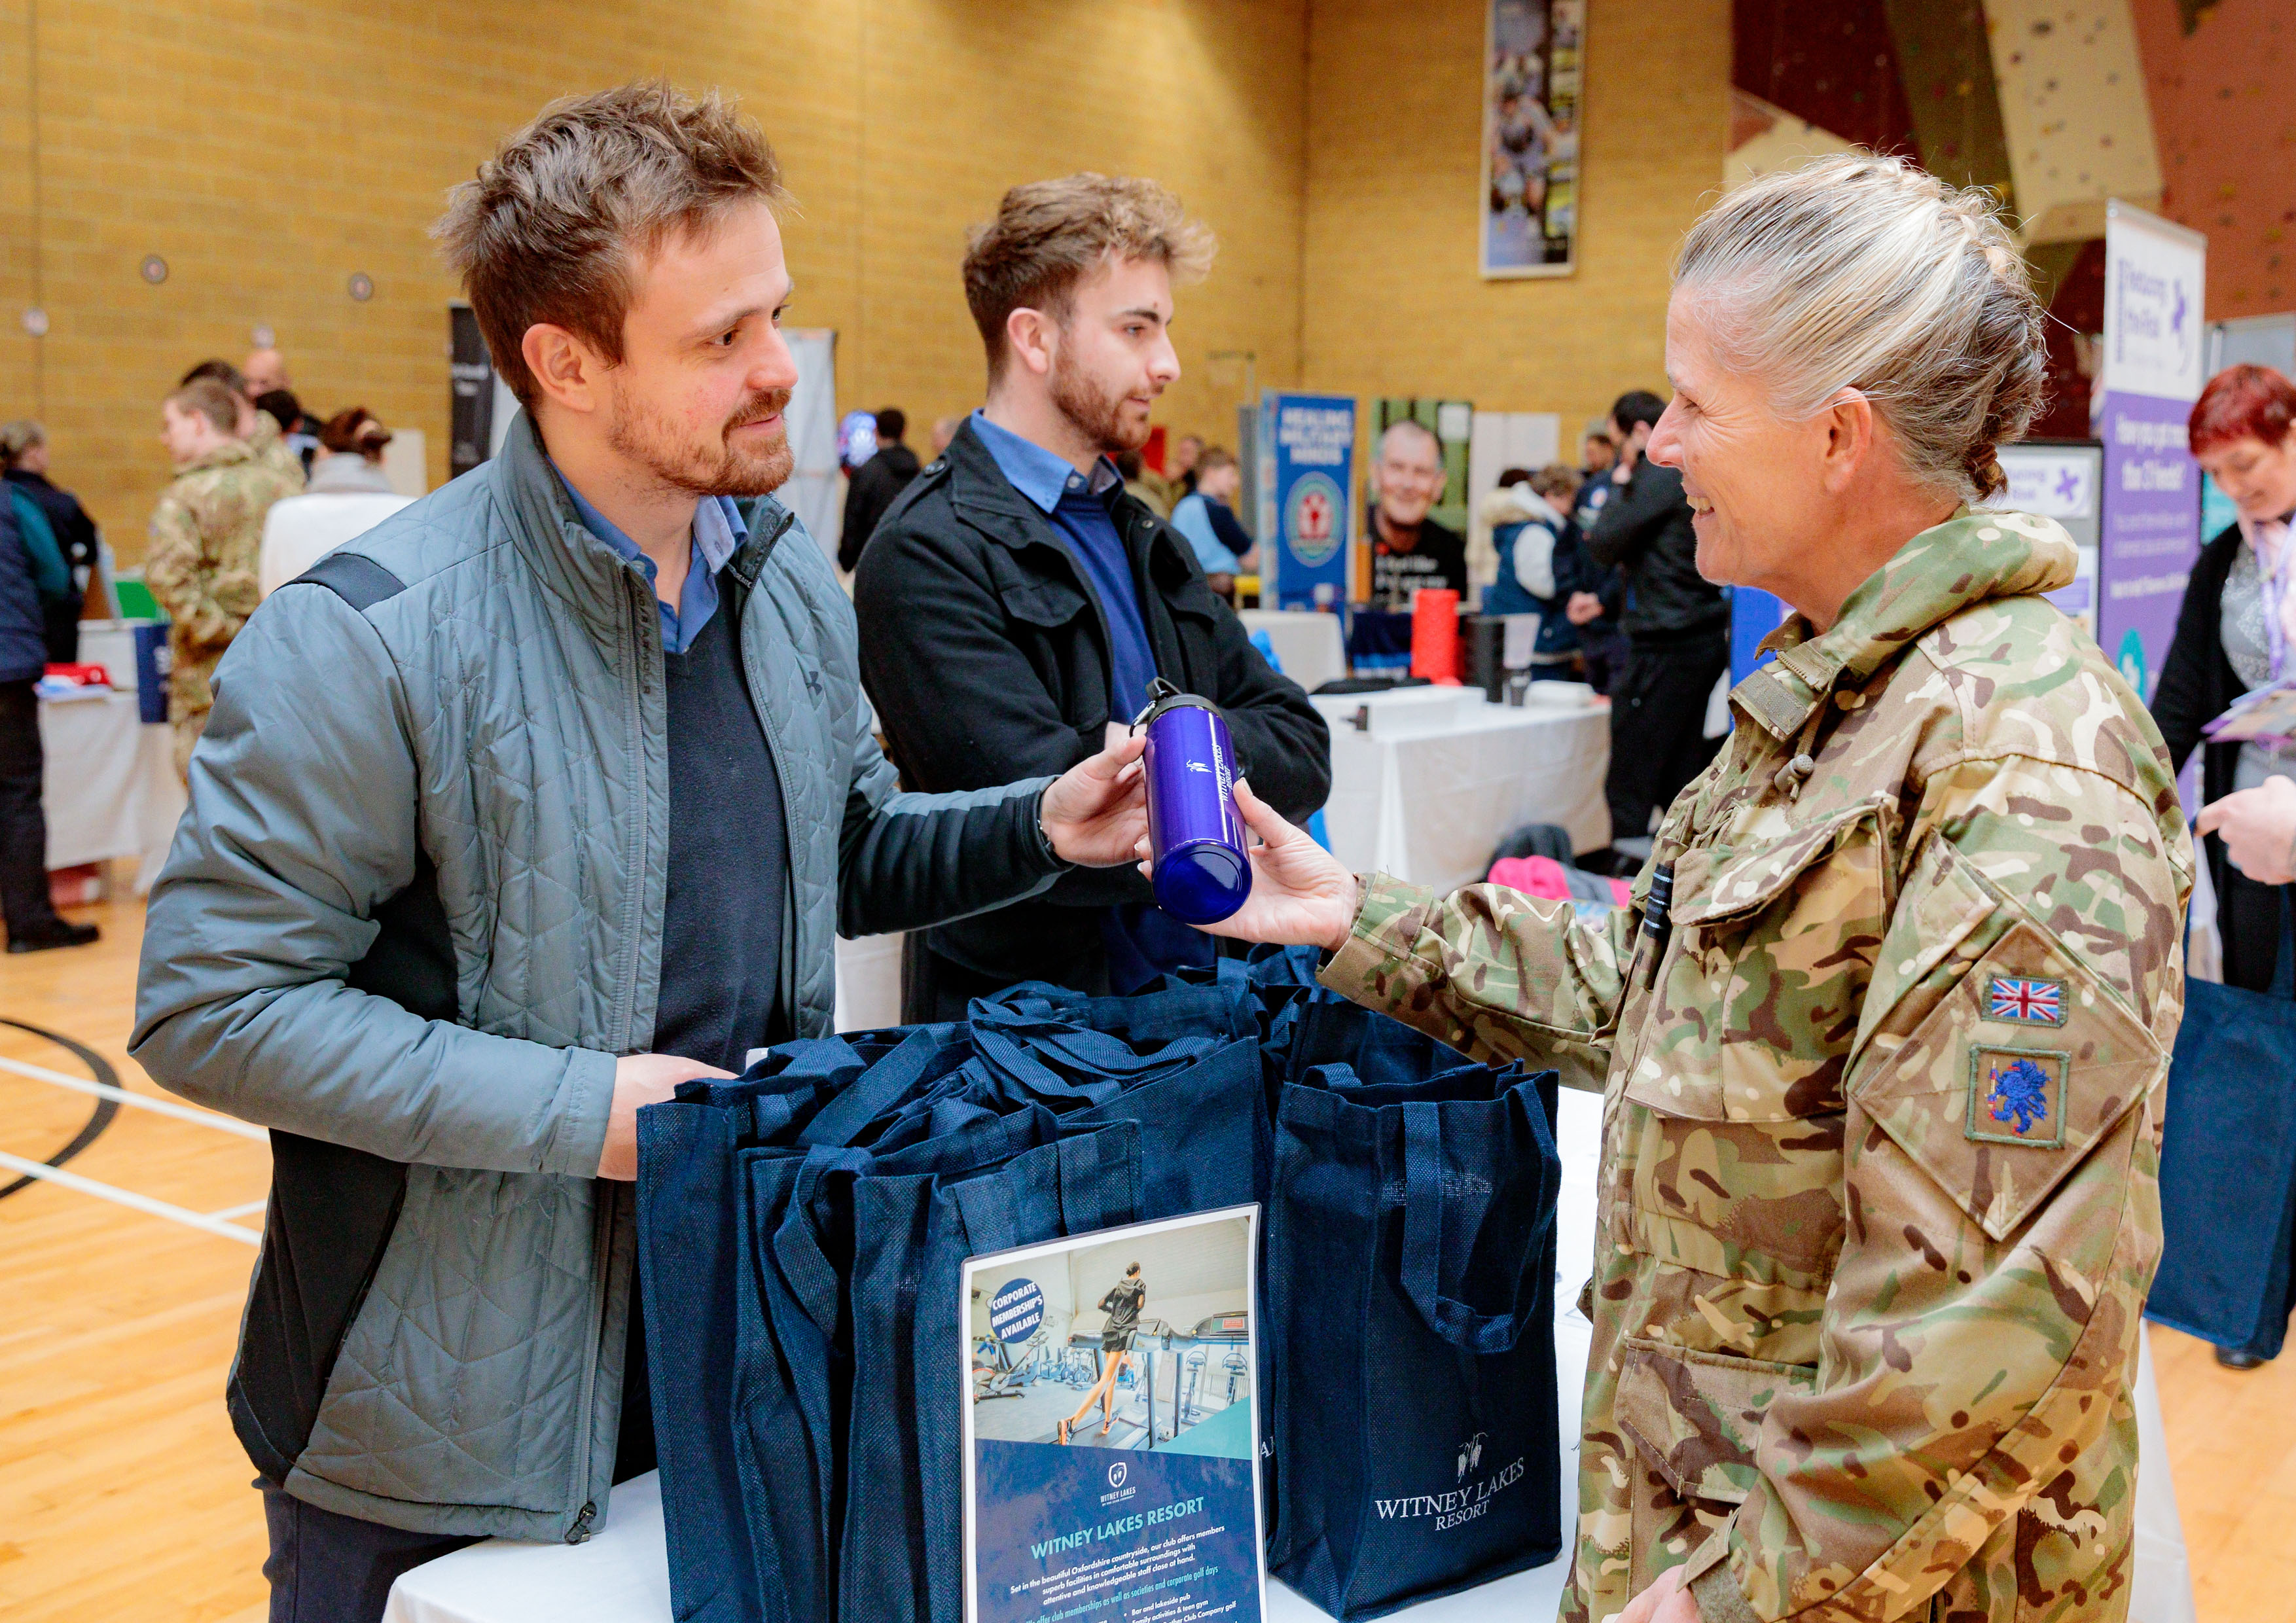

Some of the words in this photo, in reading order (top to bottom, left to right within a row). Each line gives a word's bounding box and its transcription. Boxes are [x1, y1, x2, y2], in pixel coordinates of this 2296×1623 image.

[992, 1281, 1037, 1310] CORPORATE
[992, 1294, 1043, 1327] MEMBERSHIP'S
[1001, 1311, 1041, 1340] AVAILABLE
[1100, 1491, 1119, 1503] WITNEY
[1120, 1486, 1136, 1497] LAKES
[1374, 1486, 1473, 1519] WITNEY
[1476, 1457, 1524, 1501] LAKES
[1031, 1527, 1094, 1560] WITNEY
[1097, 1513, 1143, 1543] LAKES
[1147, 1496, 1204, 1525] RESORT
[1435, 1499, 1490, 1531] RESORT
[1010, 1584, 1021, 1594] Set
[1030, 1578, 1041, 1588] the
[1041, 1568, 1071, 1584] beautiful
[1071, 1558, 1111, 1575] Oxfordshire
[1111, 1546, 1149, 1563] countryside,
[1150, 1543, 1162, 1552] our
[1162, 1537, 1177, 1548] club
[1177, 1533, 1196, 1544] offers
[1196, 1525, 1225, 1540] members
[1042, 1580, 1066, 1595] superb
[1066, 1575, 1092, 1588] facilities
[1100, 1560, 1139, 1578] comfortable
[1139, 1548, 1181, 1566] surroundings
[1181, 1544, 1196, 1555] with
[1043, 1592, 1071, 1605] attentive
[1072, 1586, 1086, 1597] and
[1086, 1570, 1137, 1593] knowledgeable
[1137, 1565, 1152, 1577] staff
[1153, 1563, 1168, 1572] close
[1169, 1559, 1176, 1567] at
[1177, 1554, 1196, 1565] hand.
[1052, 1609, 1064, 1622] club
[1065, 1599, 1102, 1618] memberships
[1110, 1591, 1122, 1603] well
[1131, 1583, 1154, 1597] societies
[1155, 1578, 1166, 1590] and
[1167, 1572, 1193, 1587] corporate
[1193, 1567, 1204, 1581] golf
[1205, 1565, 1219, 1576] days
[1143, 1603, 1154, 1613] and
[1155, 1596, 1179, 1609] lakeside
[1179, 1592, 1191, 1603] pub
[1152, 1609, 1176, 1621] activities
[1182, 1603, 1196, 1612] teen
[1196, 1599, 1209, 1609] gym
[1183, 1613, 1197, 1622] Club
[1197, 1605, 1225, 1619] Company
[1225, 1600, 1237, 1612] golf
